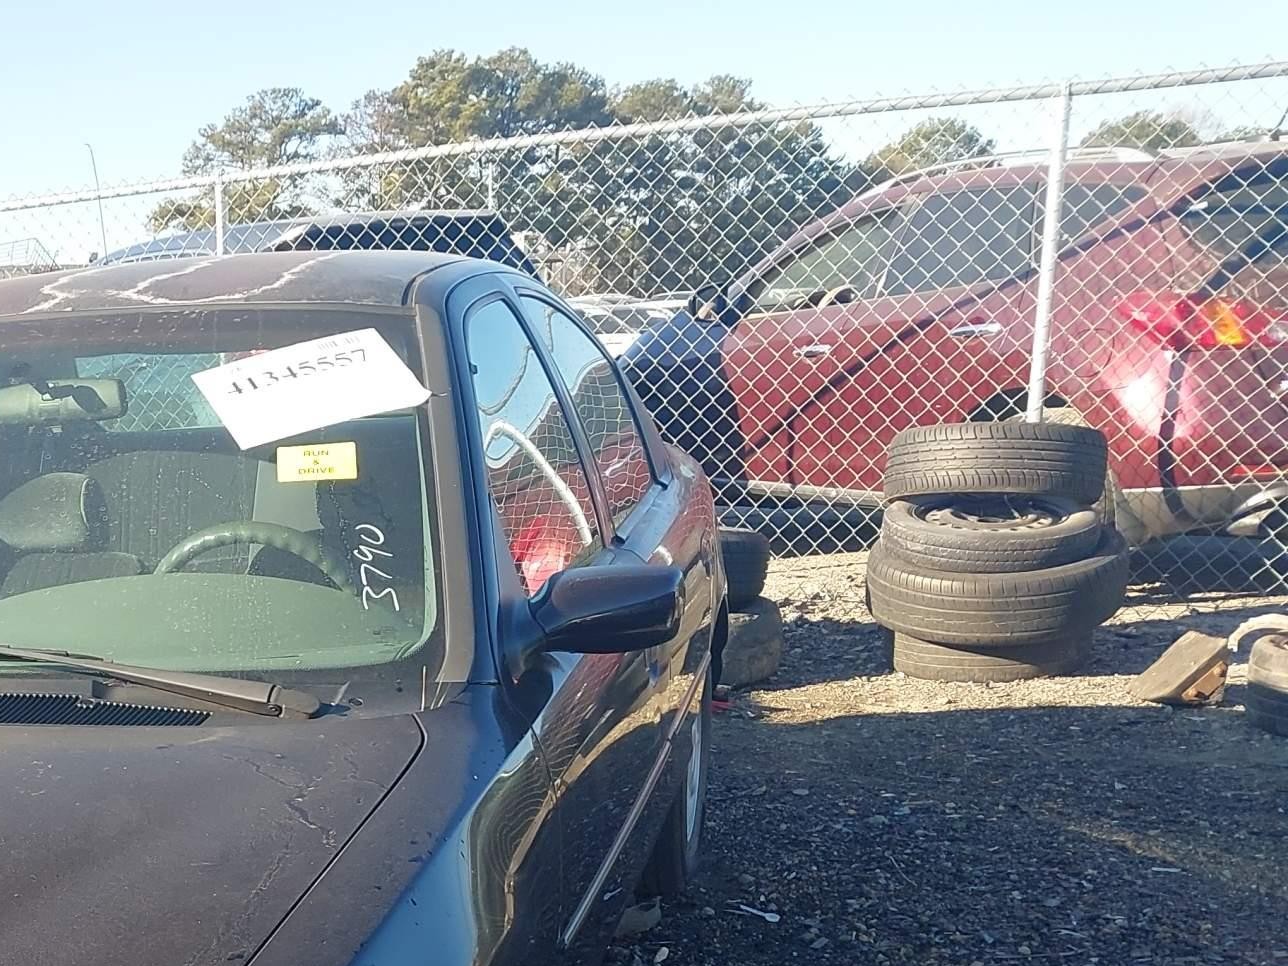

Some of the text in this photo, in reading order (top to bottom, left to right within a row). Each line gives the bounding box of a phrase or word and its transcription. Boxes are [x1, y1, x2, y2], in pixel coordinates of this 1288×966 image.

[227, 348, 367, 394] 41345557
[298, 467, 335, 475] DRIVE
[353, 523, 400, 612] 3790
